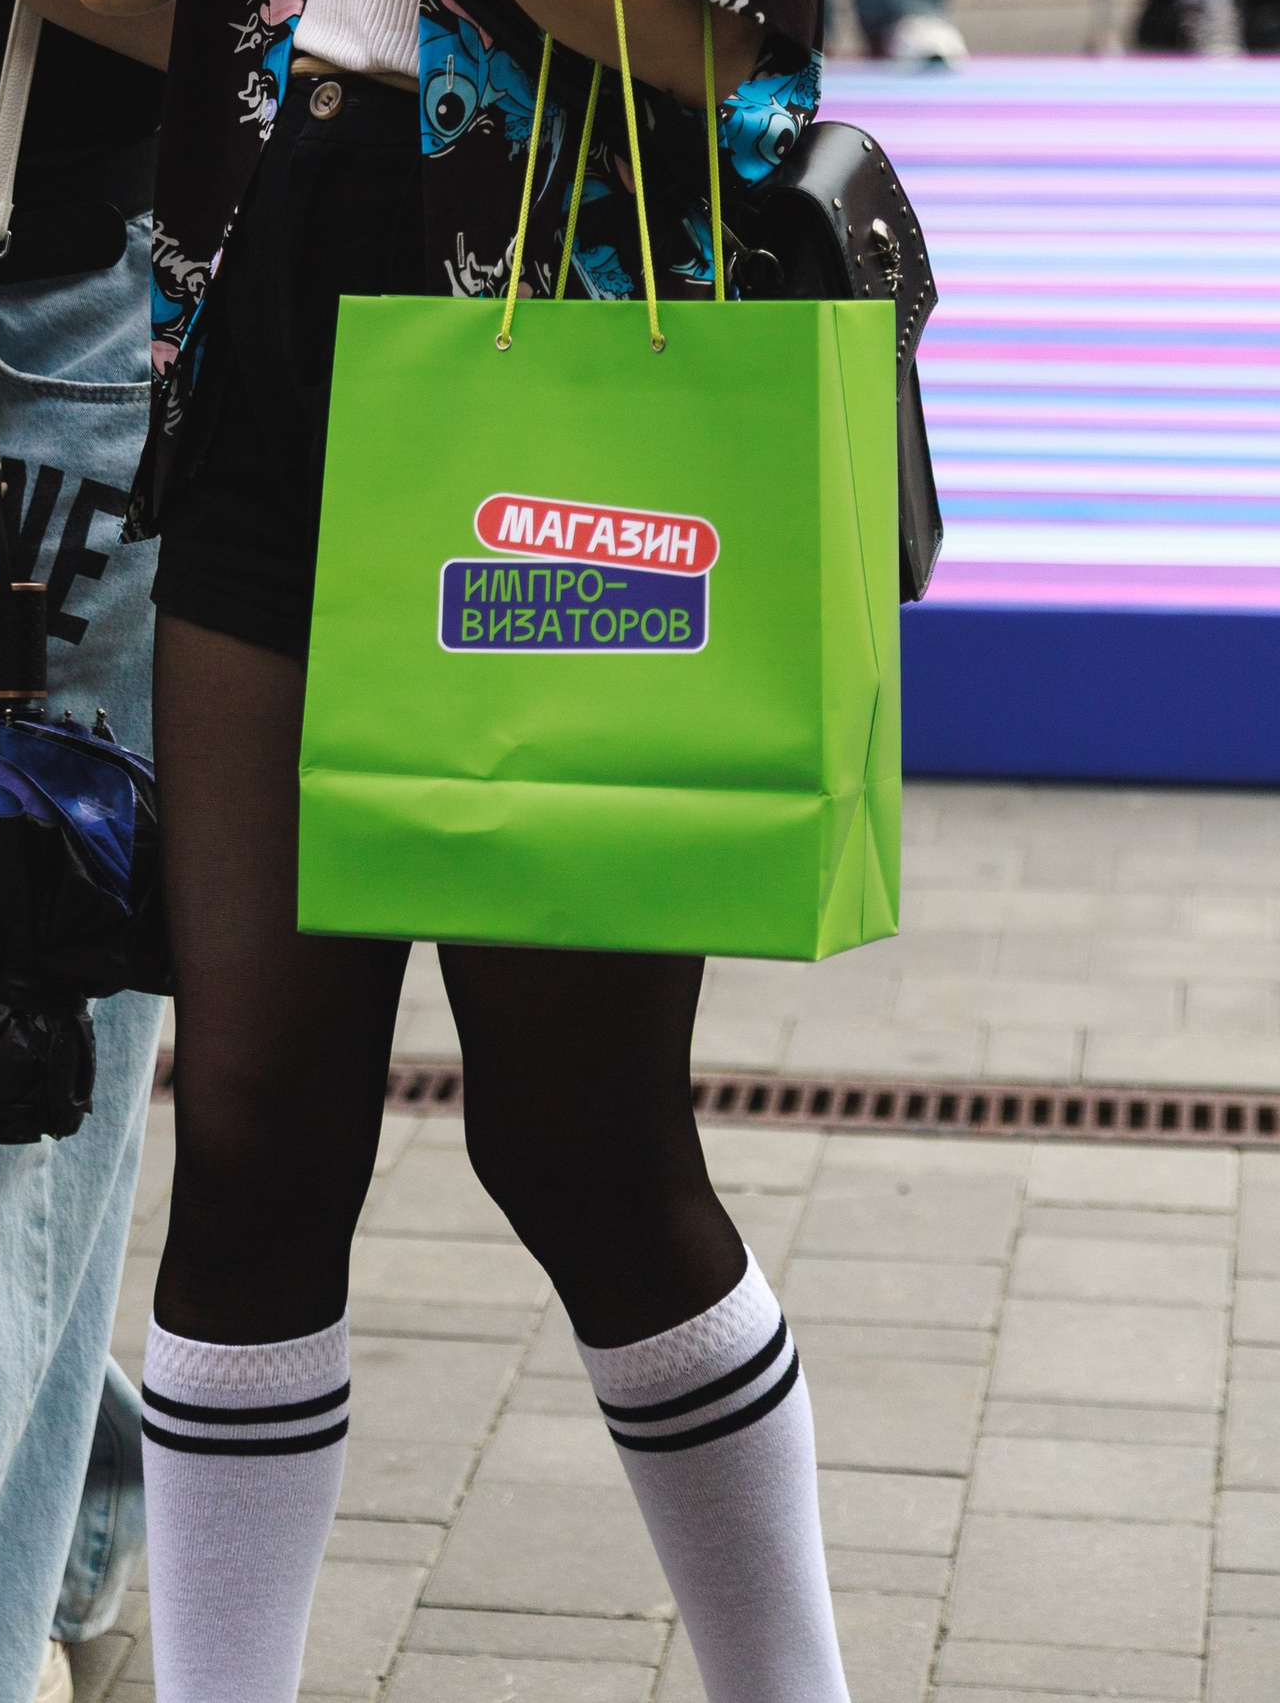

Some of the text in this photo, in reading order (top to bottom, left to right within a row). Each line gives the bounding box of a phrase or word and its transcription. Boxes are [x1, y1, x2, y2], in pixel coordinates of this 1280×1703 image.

[497, 504, 698, 565] МАГАЗИН
[464, 568, 628, 603] ИМПРО-
[461, 608, 692, 643] ВИЗАТОРОВ
